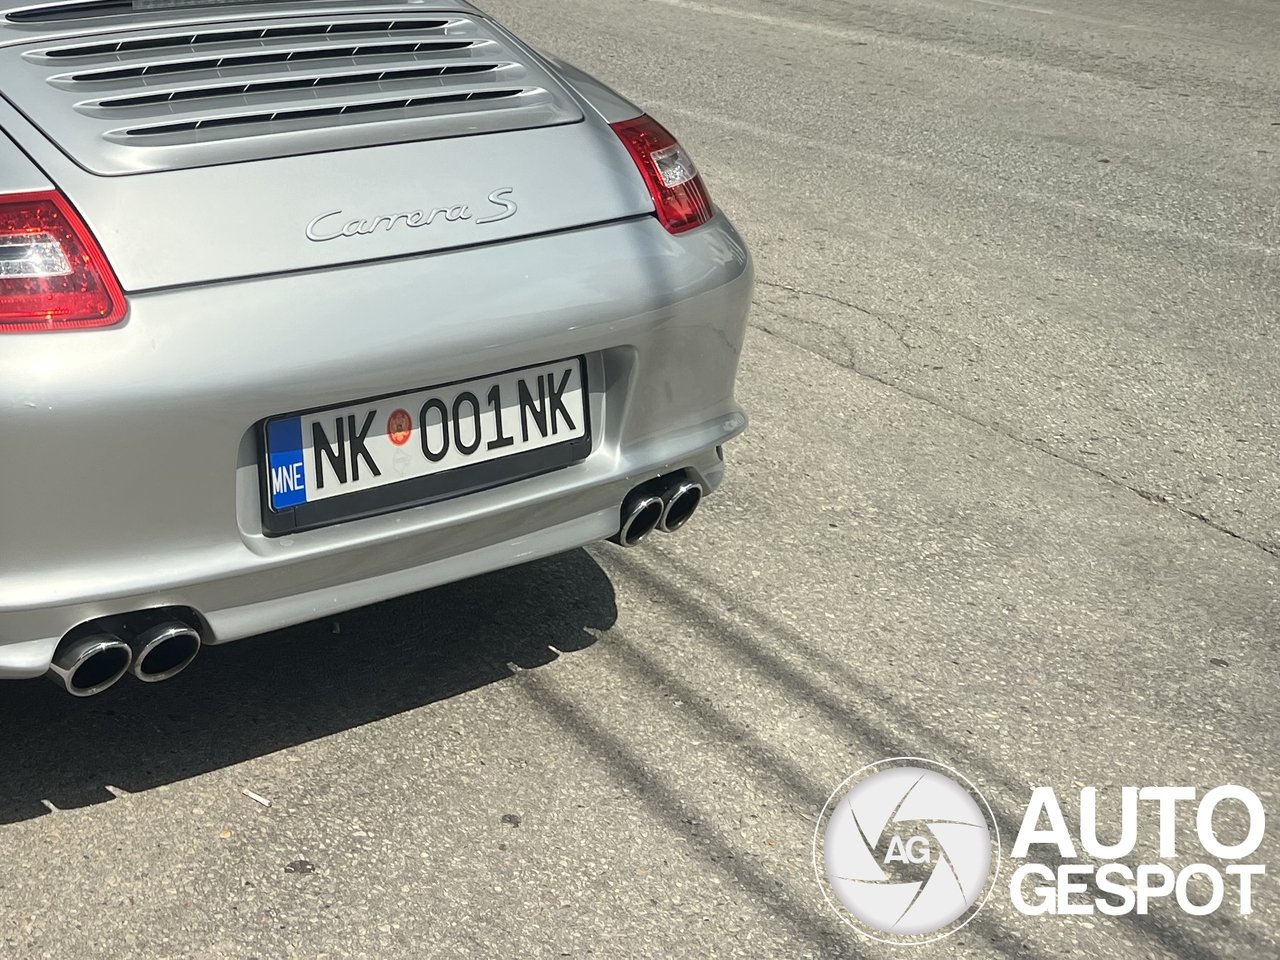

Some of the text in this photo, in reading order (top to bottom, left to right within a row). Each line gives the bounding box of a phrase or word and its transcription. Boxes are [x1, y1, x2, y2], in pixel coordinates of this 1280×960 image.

[305, 187, 518, 242] Carrera S
[312, 369, 577, 489] NK 001 NK
[272, 462, 305, 496] MNE
